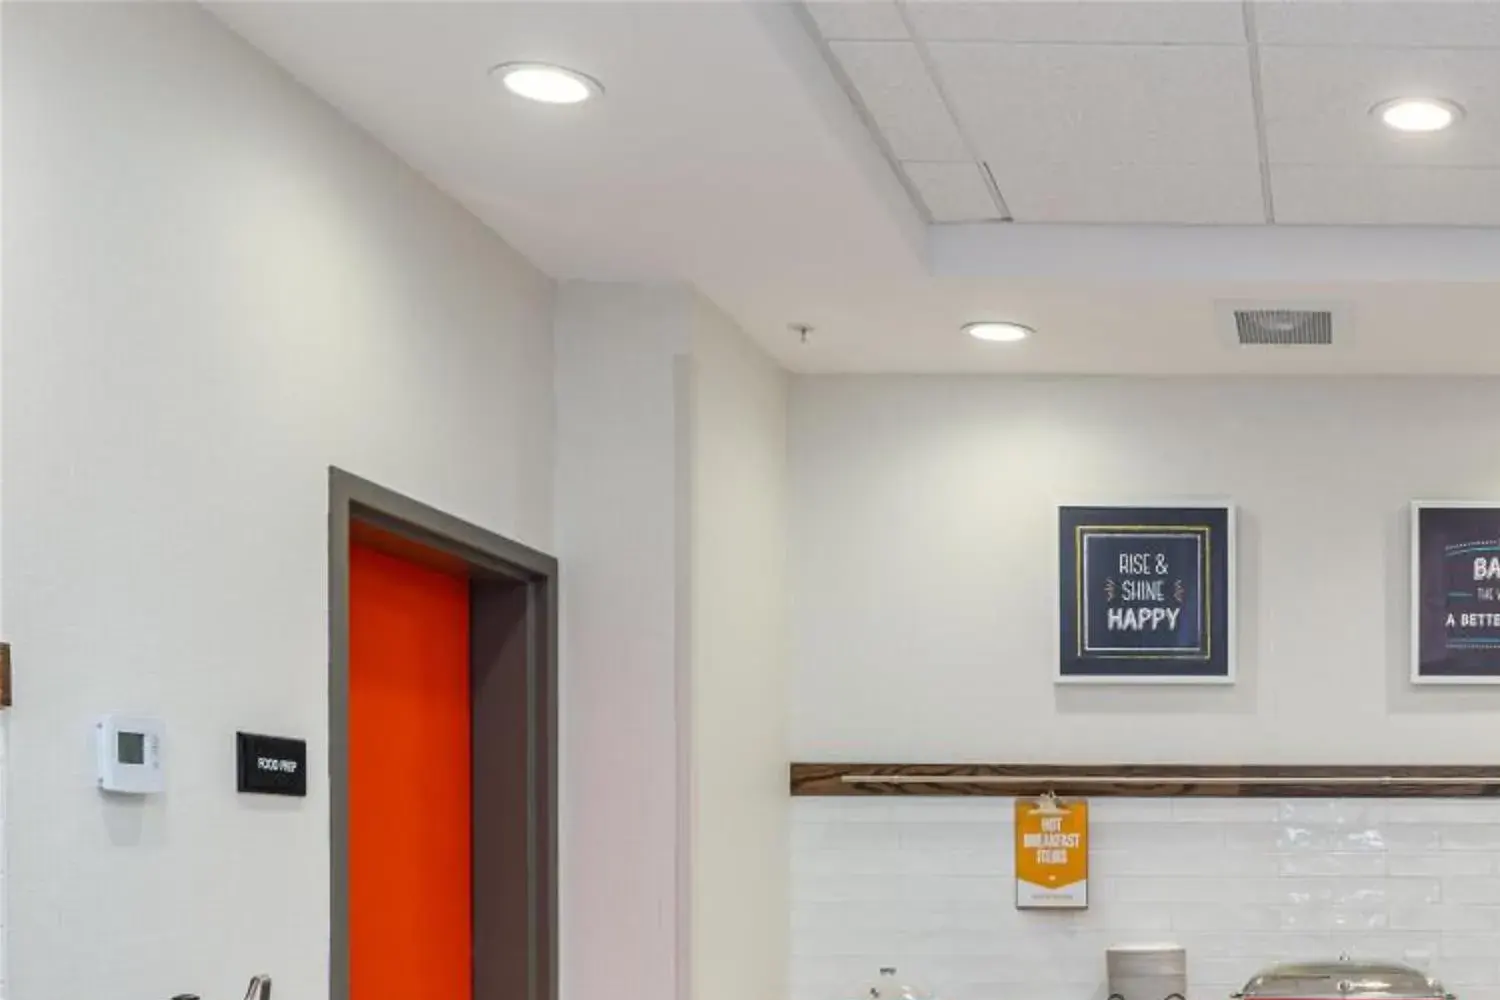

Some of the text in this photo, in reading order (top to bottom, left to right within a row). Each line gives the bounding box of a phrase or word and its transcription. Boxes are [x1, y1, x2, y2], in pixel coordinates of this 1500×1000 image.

[1119, 553, 1168, 575] RISE &
[1121, 579, 1164, 601] SHINE
[1107, 607, 1181, 631] HAPPY
[1445, 613, 1456, 628] A
[257, 757, 297, 773] FOOD PREP
[1041, 816, 1062, 832] HOT
[1023, 832, 1080, 848] BREAKFAST
